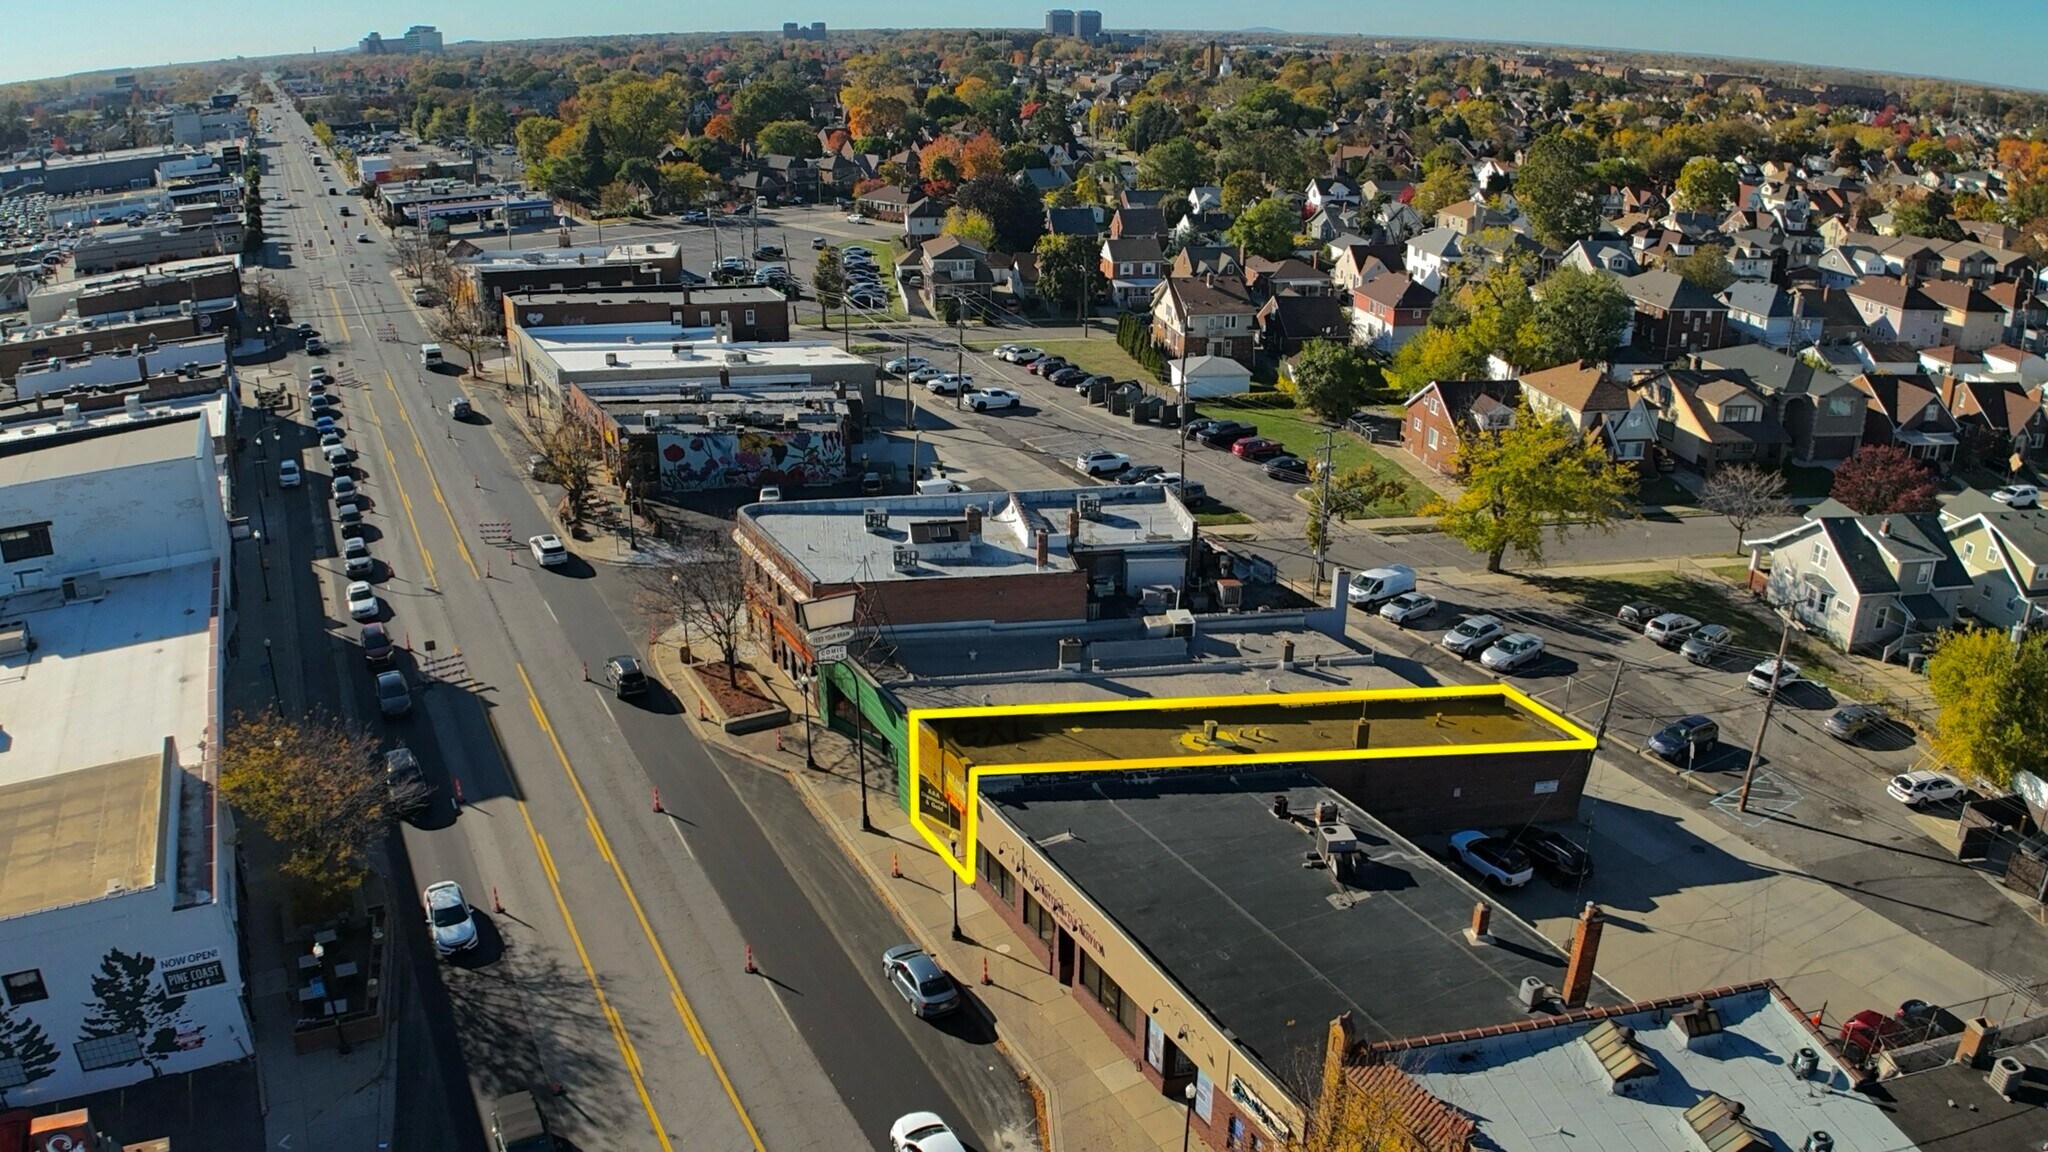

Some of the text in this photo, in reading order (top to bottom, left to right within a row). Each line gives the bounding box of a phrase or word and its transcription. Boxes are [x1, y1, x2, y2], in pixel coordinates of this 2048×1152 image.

[813, 635, 824, 643] FEED
[825, 633, 836, 641] YOUR
[821, 647, 844, 656] COMIC
[821, 653, 845, 662] BOOKS
[927, 788, 940, 799] AAA
[920, 791, 948, 808] Diamonds
[930, 801, 944, 813] Gold
[160, 955, 186, 969] NOW
[167, 965, 220, 986] PINE COAST
